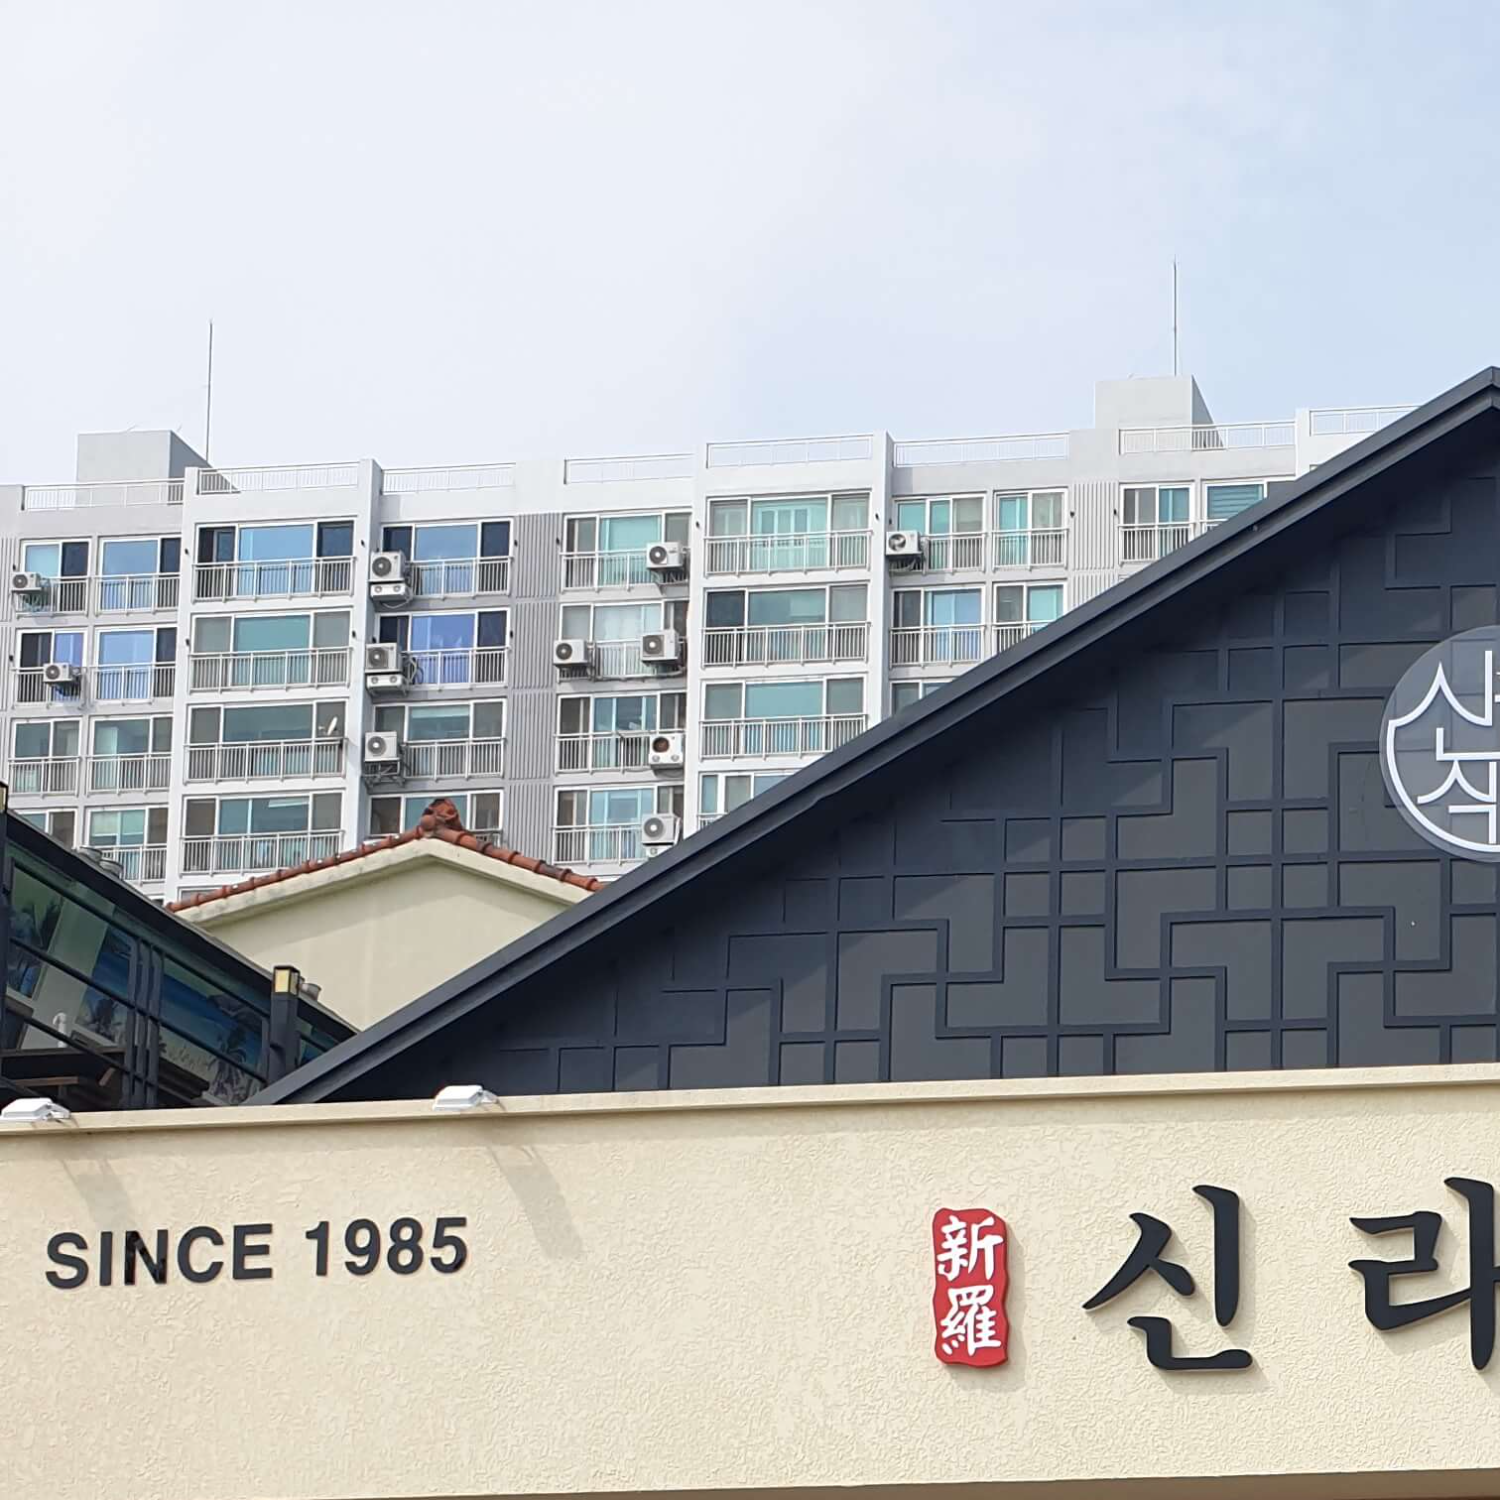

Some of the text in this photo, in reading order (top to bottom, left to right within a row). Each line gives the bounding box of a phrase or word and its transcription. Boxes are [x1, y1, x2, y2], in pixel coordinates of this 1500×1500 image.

[46, 1217, 467, 1289] SINCE 1985
[935, 1214, 1003, 1357] 新羅
